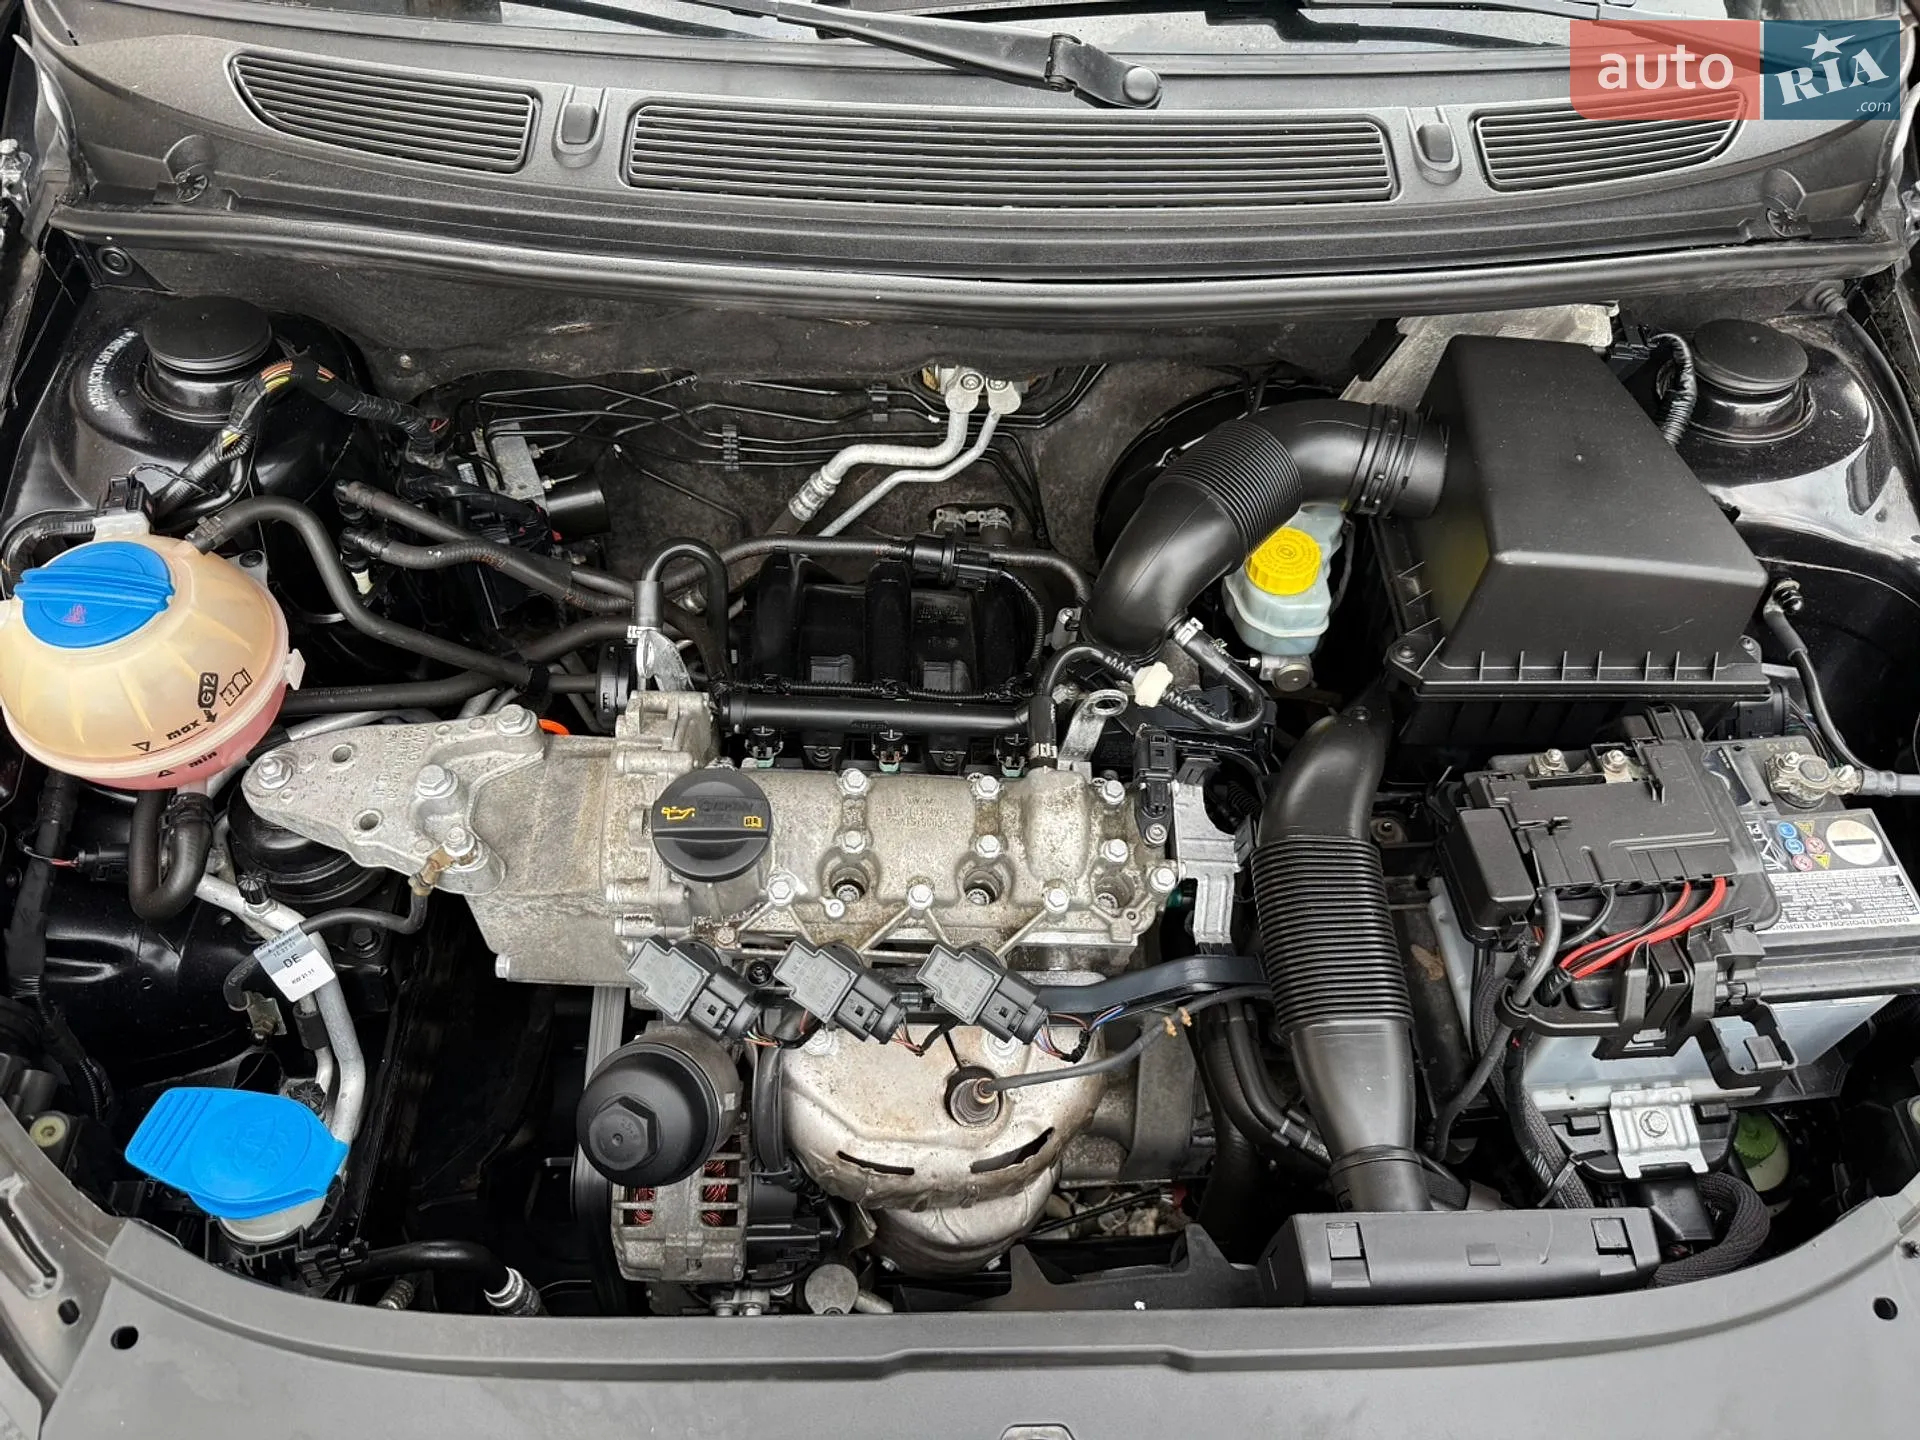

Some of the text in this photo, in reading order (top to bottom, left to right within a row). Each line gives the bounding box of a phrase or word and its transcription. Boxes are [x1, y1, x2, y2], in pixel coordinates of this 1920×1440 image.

[201, 675, 216, 704] G12
[166, 720, 201, 740] max
[188, 751, 217, 768] min
[283, 953, 302, 968] DE
